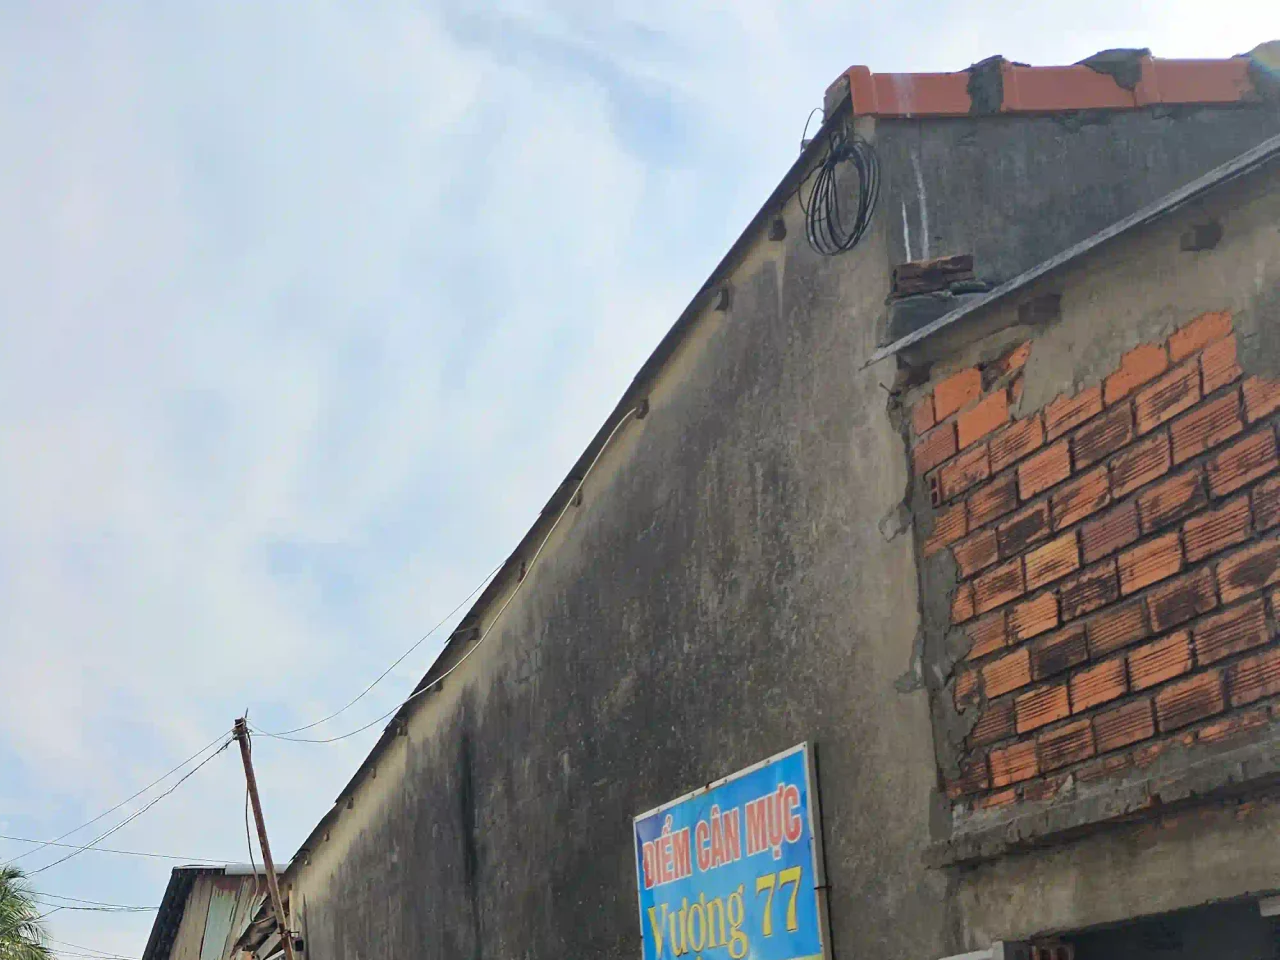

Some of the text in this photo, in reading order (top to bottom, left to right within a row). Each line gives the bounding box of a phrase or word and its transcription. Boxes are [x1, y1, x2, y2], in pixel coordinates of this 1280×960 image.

[642, 783, 803, 891] ĐIỂM CÂN MỰC
[755, 865, 803, 937] 77
